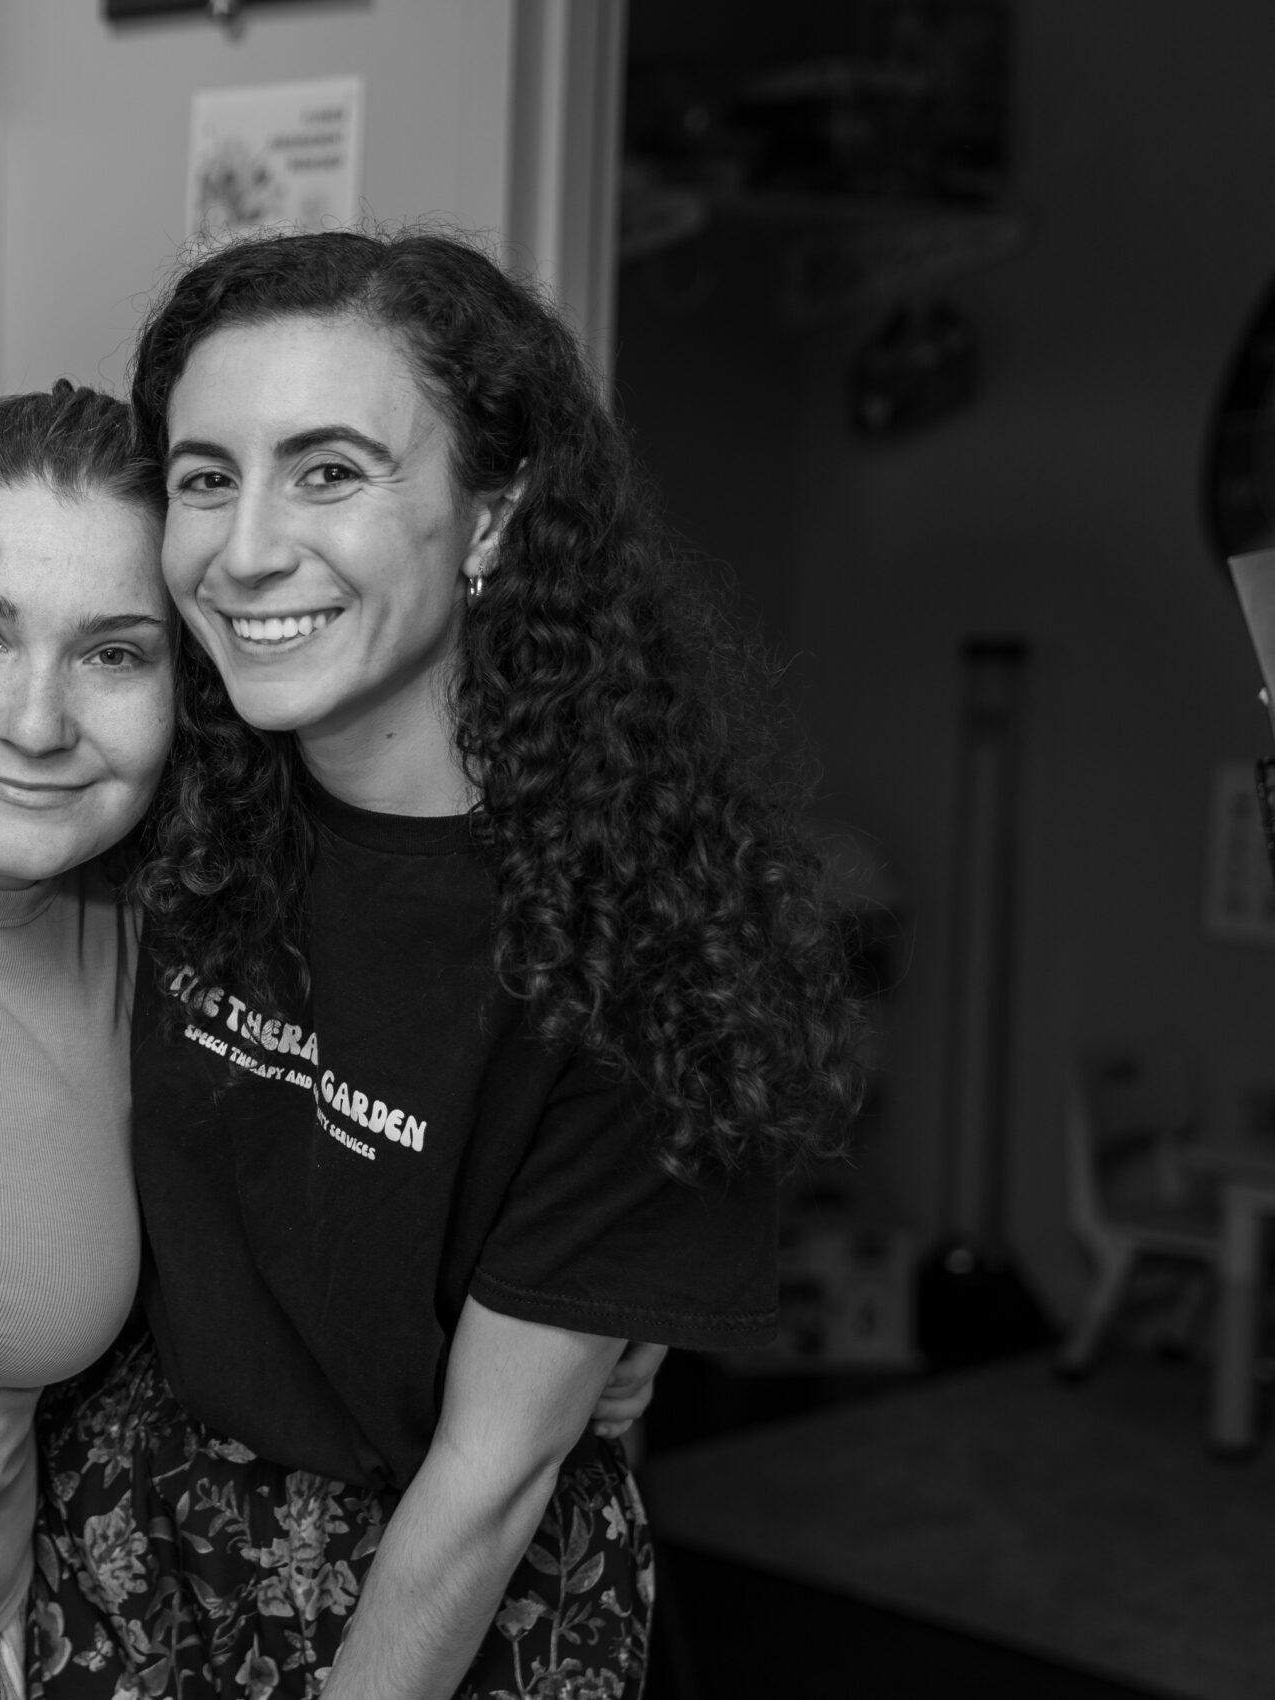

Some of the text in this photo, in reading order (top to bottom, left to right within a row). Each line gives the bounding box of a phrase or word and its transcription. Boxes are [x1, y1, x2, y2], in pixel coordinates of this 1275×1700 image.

[183, 1023, 376, 1161] SPEECH THERAPY AND SERVICES
[226, 994, 319, 1067] THERA
[321, 1069, 428, 1152] GARDEN
